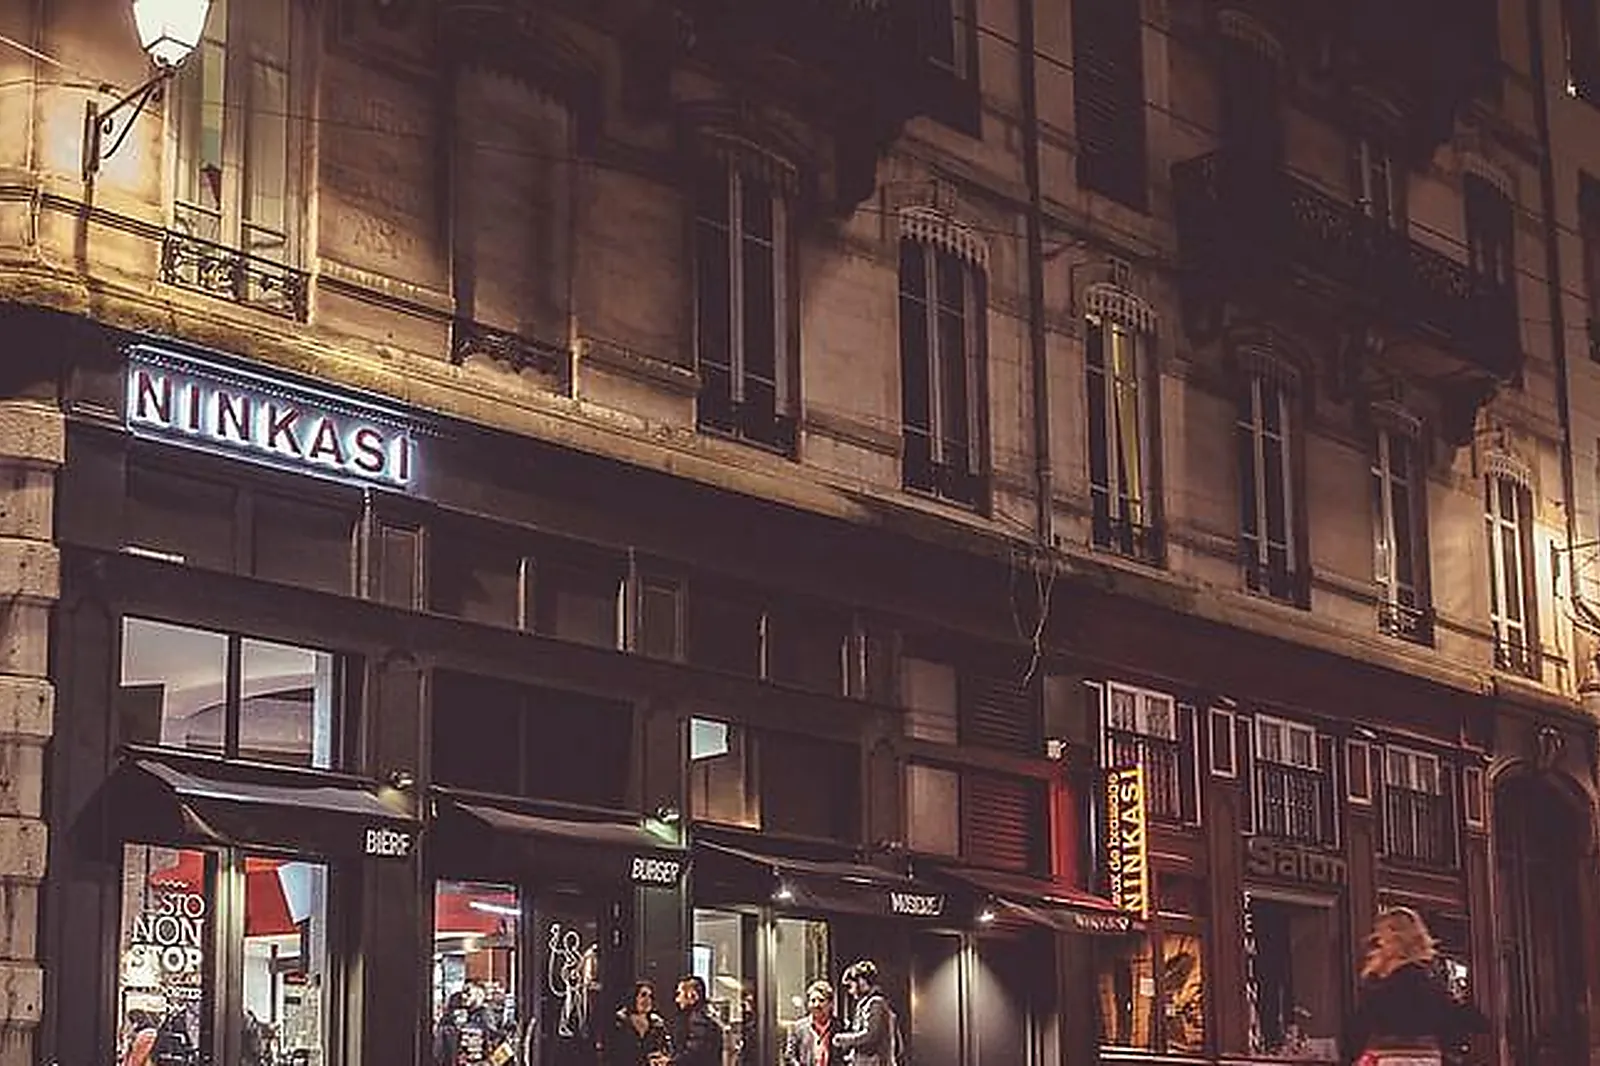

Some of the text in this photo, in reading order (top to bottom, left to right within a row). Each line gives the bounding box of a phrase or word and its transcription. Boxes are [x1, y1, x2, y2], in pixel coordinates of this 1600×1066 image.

[134, 369, 411, 482] NINKASI
[1120, 767, 1141, 911] NINKASI
[1248, 836, 1347, 885] Salon
[131, 914, 206, 948] NON
[130, 944, 205, 973] STOP
